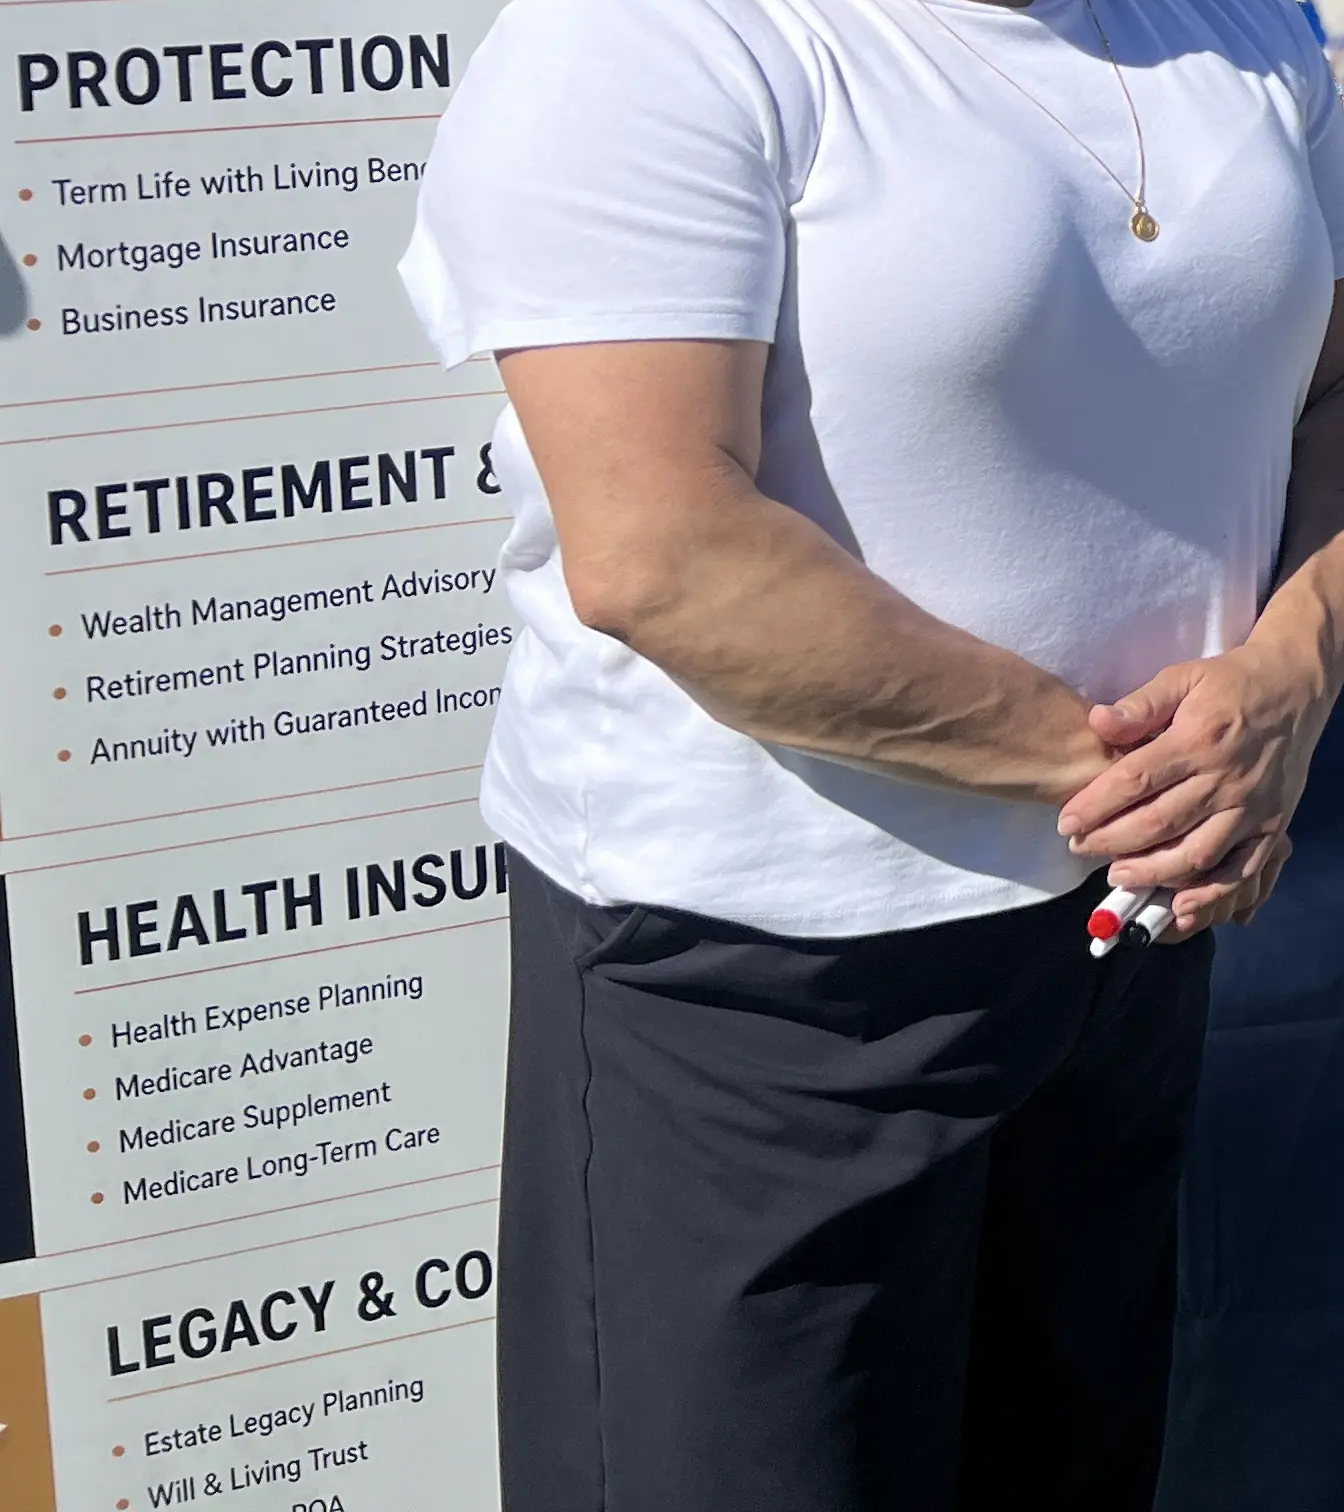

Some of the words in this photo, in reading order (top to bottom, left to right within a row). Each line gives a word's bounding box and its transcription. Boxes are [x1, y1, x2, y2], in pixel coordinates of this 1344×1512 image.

[19, 34, 450, 111] PROTECTION
[58, 242, 200, 271] Mortgage
[212, 230, 348, 258] Insurance
[62, 305, 188, 334] Business
[200, 294, 335, 322] Insurance
[49, 446, 454, 544] RETIREMENT
[82, 603, 180, 638] Wealth
[192, 581, 373, 625] Management
[382, 569, 495, 600] Advisory
[88, 659, 244, 702] Retirement
[255, 644, 370, 678] Planning
[381, 624, 512, 660] Strategies
[78, 874, 322, 965] HEALTH
[112, 1012, 195, 1048] Health
[206, 997, 310, 1031] Expense
[320, 975, 422, 1010] Planning
[116, 1064, 231, 1100] Medicare
[240, 1038, 372, 1077] Advantage
[120, 1116, 234, 1152] Medicare
[244, 1082, 391, 1129] Supplement
[124, 1168, 238, 1204] Medicare
[248, 1140, 376, 1179] Long-Term
[386, 1128, 439, 1151] Care
[108, 1281, 335, 1376] LEGACY
[359, 1272, 396, 1321] &
[416, 1251, 492, 1308] CO
[145, 1424, 221, 1456] Estate
[230, 1403, 314, 1437] Legacy
[324, 1380, 423, 1416] Planning
[148, 1477, 194, 1508] Will
[204, 1473, 222, 1495] &
[231, 1460, 300, 1490] Living
[308, 1441, 368, 1470] Trust
